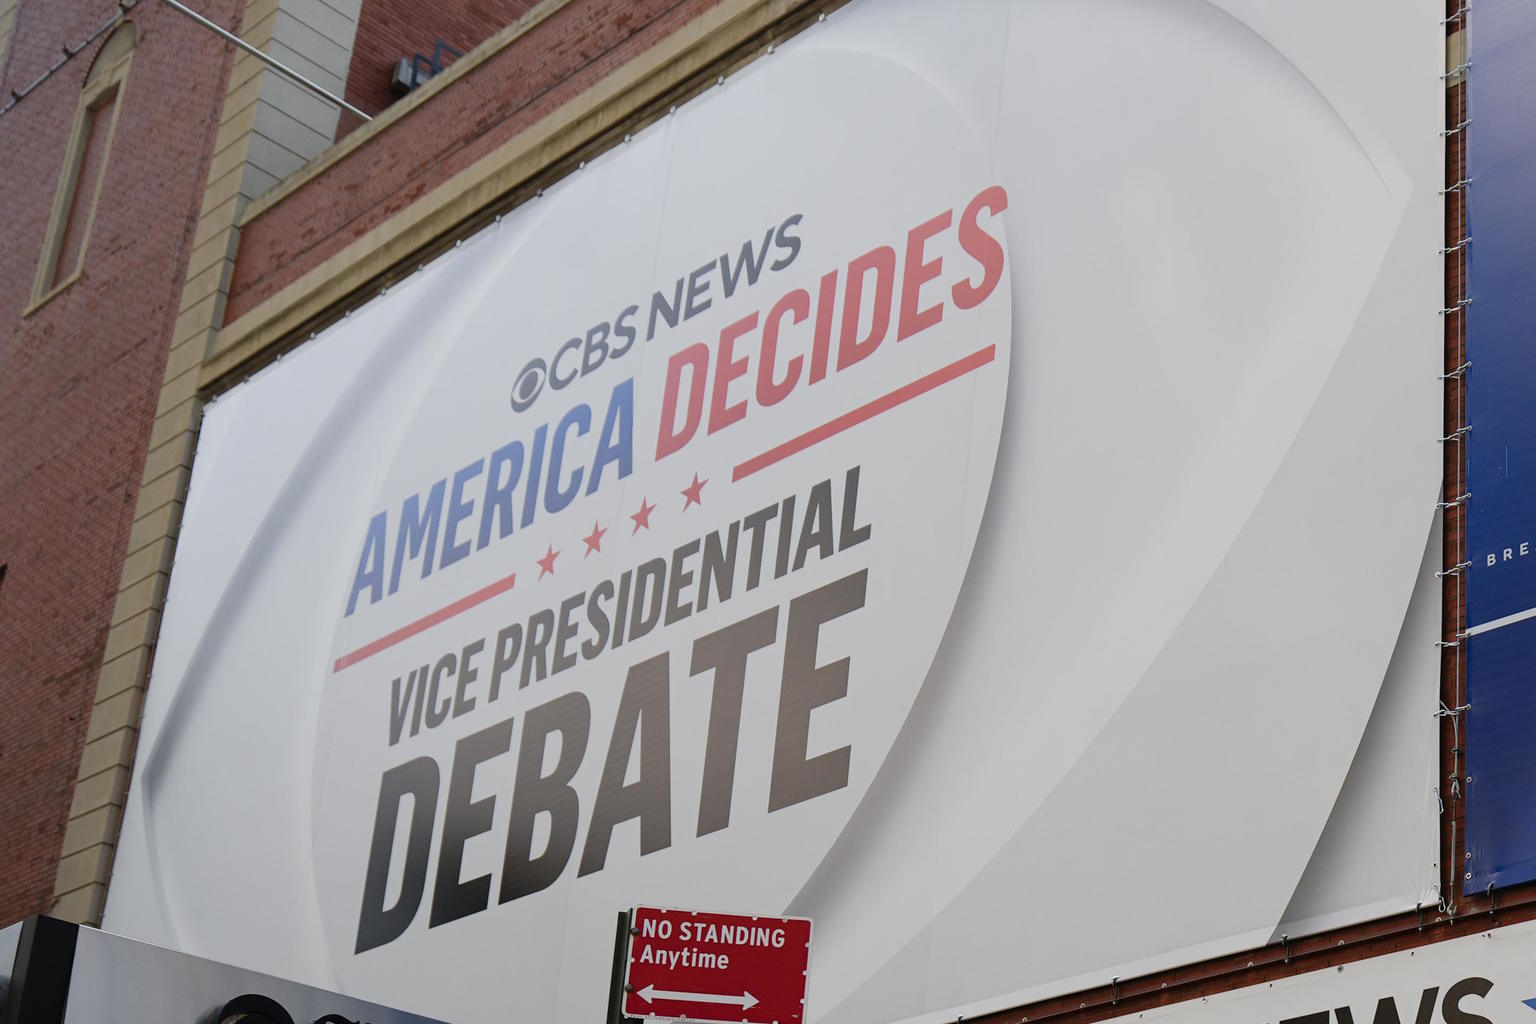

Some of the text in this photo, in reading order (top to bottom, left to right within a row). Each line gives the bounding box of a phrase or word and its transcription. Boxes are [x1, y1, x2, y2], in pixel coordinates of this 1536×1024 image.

[344, 185, 1008, 618] AMERICA DECIDES
[550, 214, 803, 392] CBS NEWS
[388, 465, 872, 746] VICE PRESIDENTIAL
[354, 568, 870, 955] DEBATE
[640, 944, 729, 970] Anytime
[642, 918, 785, 948] NO STANDING
